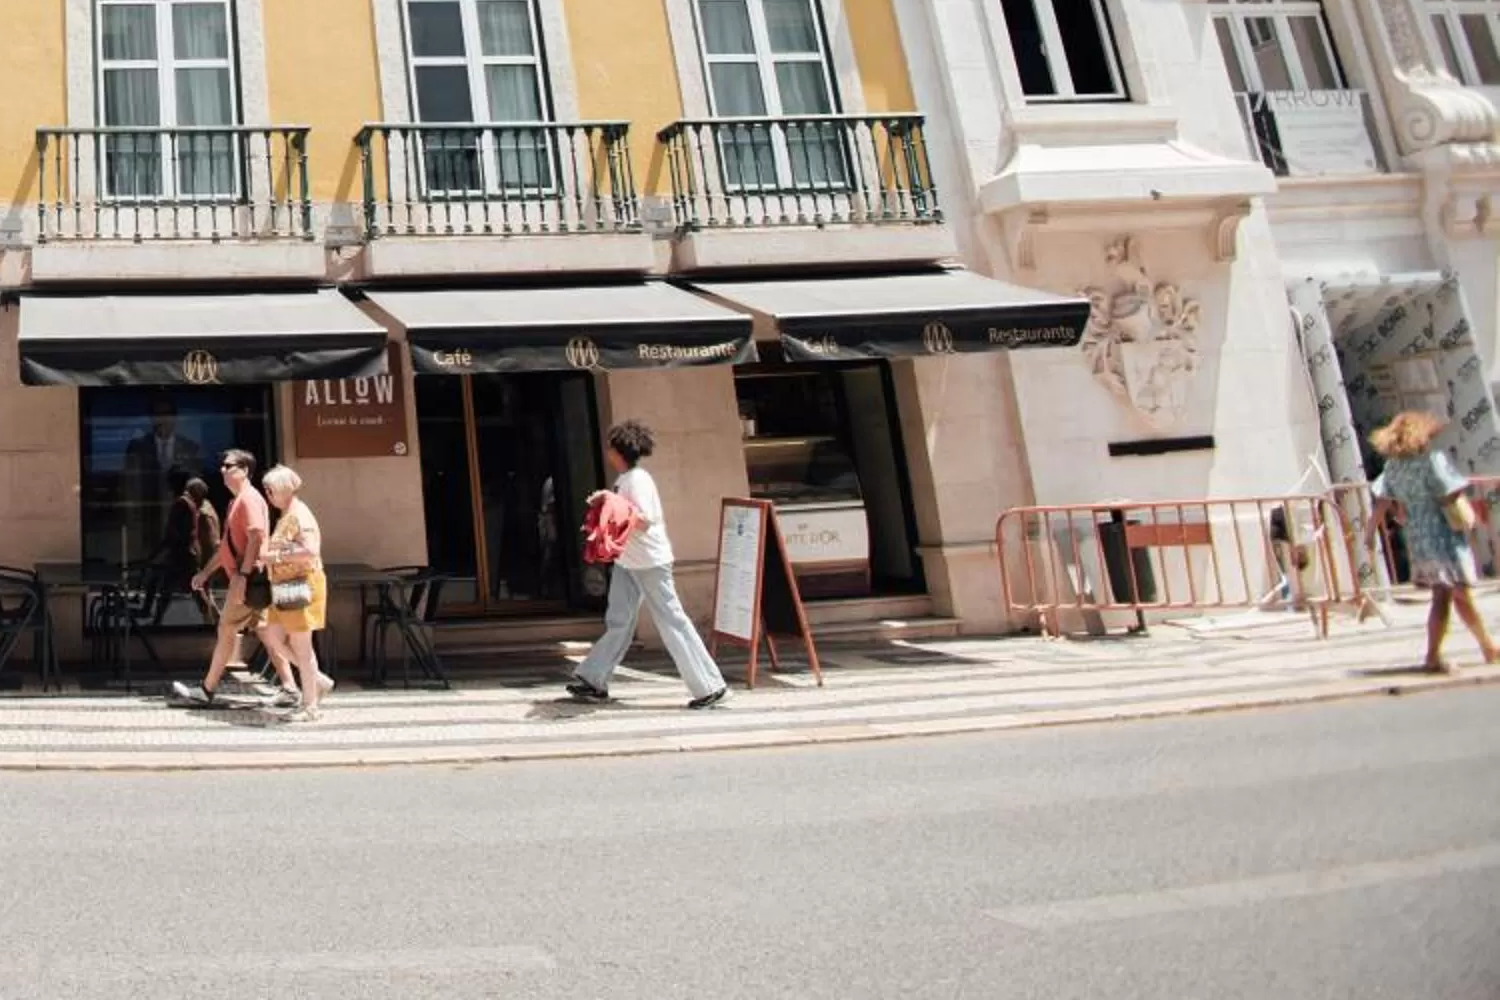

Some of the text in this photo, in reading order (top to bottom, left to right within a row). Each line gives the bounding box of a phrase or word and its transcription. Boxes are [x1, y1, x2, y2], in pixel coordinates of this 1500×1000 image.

[988, 326, 1077, 345] Restaurante
[432, 347, 473, 367] Café
[637, 342, 737, 360] Restaurante
